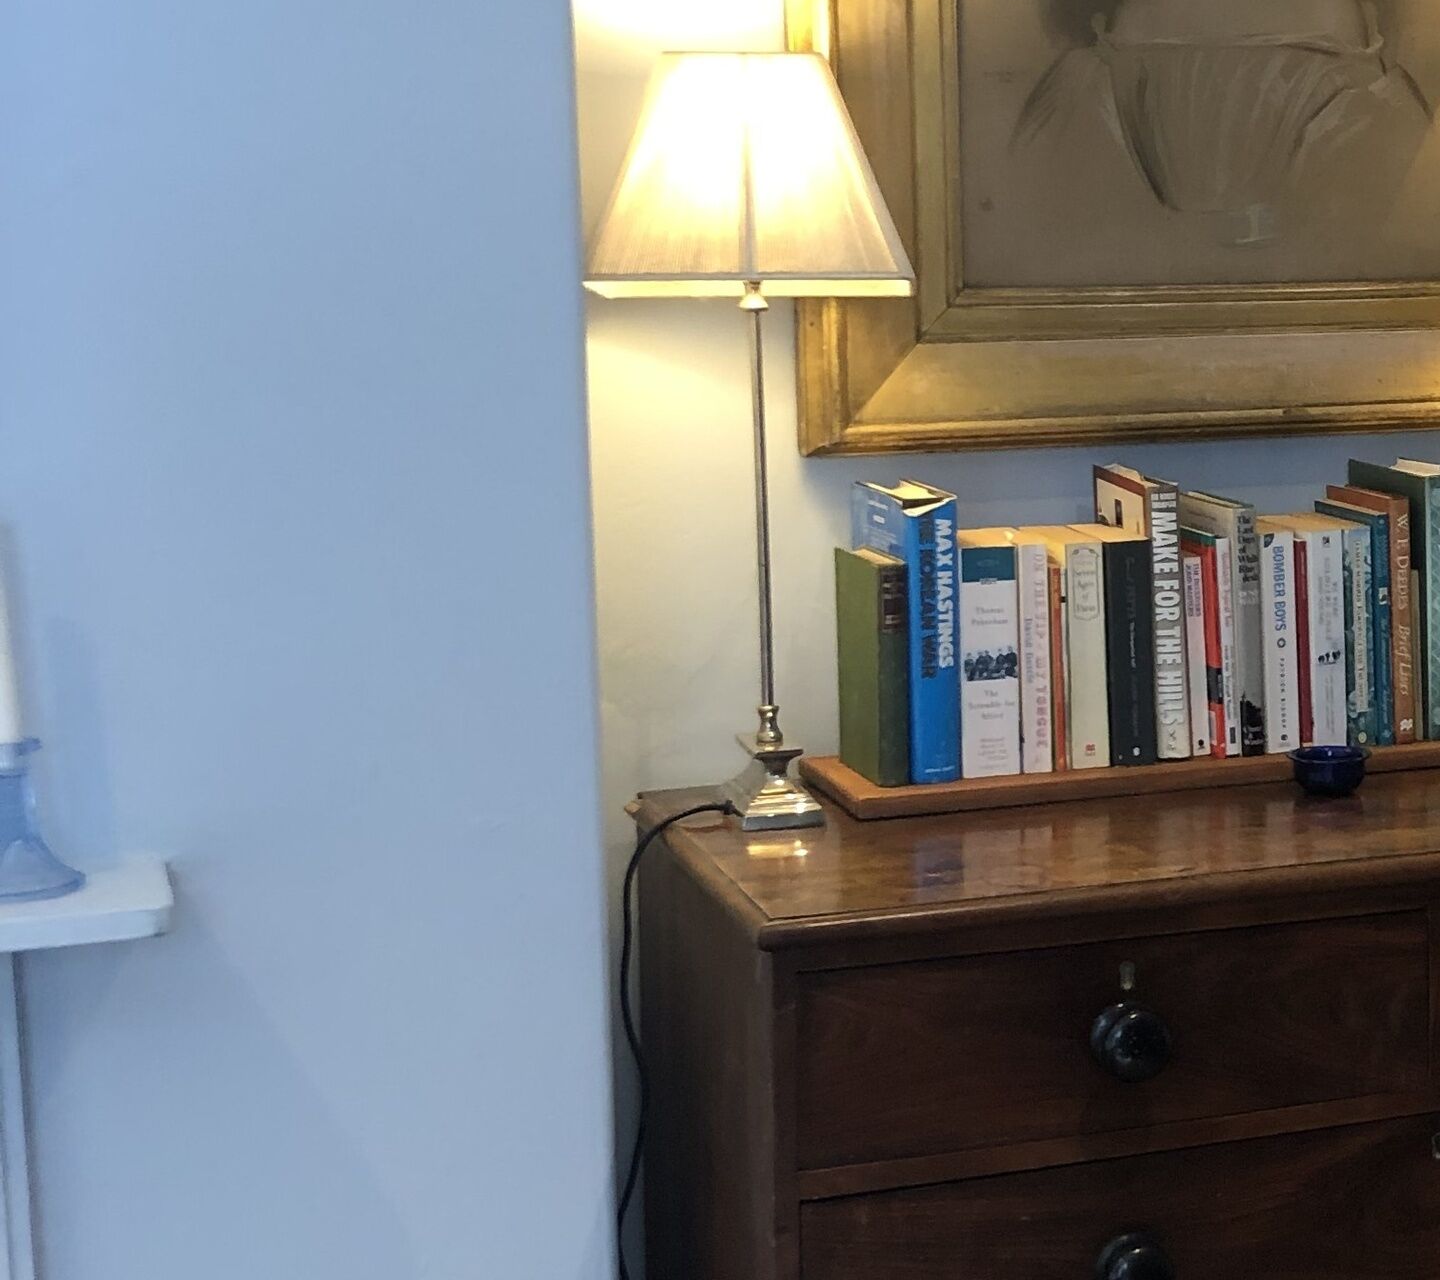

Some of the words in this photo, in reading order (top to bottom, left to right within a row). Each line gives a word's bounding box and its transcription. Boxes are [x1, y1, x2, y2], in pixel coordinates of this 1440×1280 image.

[935, 518, 954, 567] MAX
[1151, 511, 1180, 574] MAKE
[919, 549, 937, 631] KOREAN
[1272, 546, 1287, 597] BOMBER
[1397, 556, 1410, 611] DEEDES
[937, 571, 955, 668] HASTINGS
[1153, 580, 1182, 622] FOR
[1274, 601, 1287, 631] BOYS
[921, 635, 938, 679] WAR
[1155, 626, 1183, 665] THE
[1395, 625, 1411, 660] Brief
[1156, 671, 1185, 725] HILLS
[1399, 663, 1412, 696] Lives
